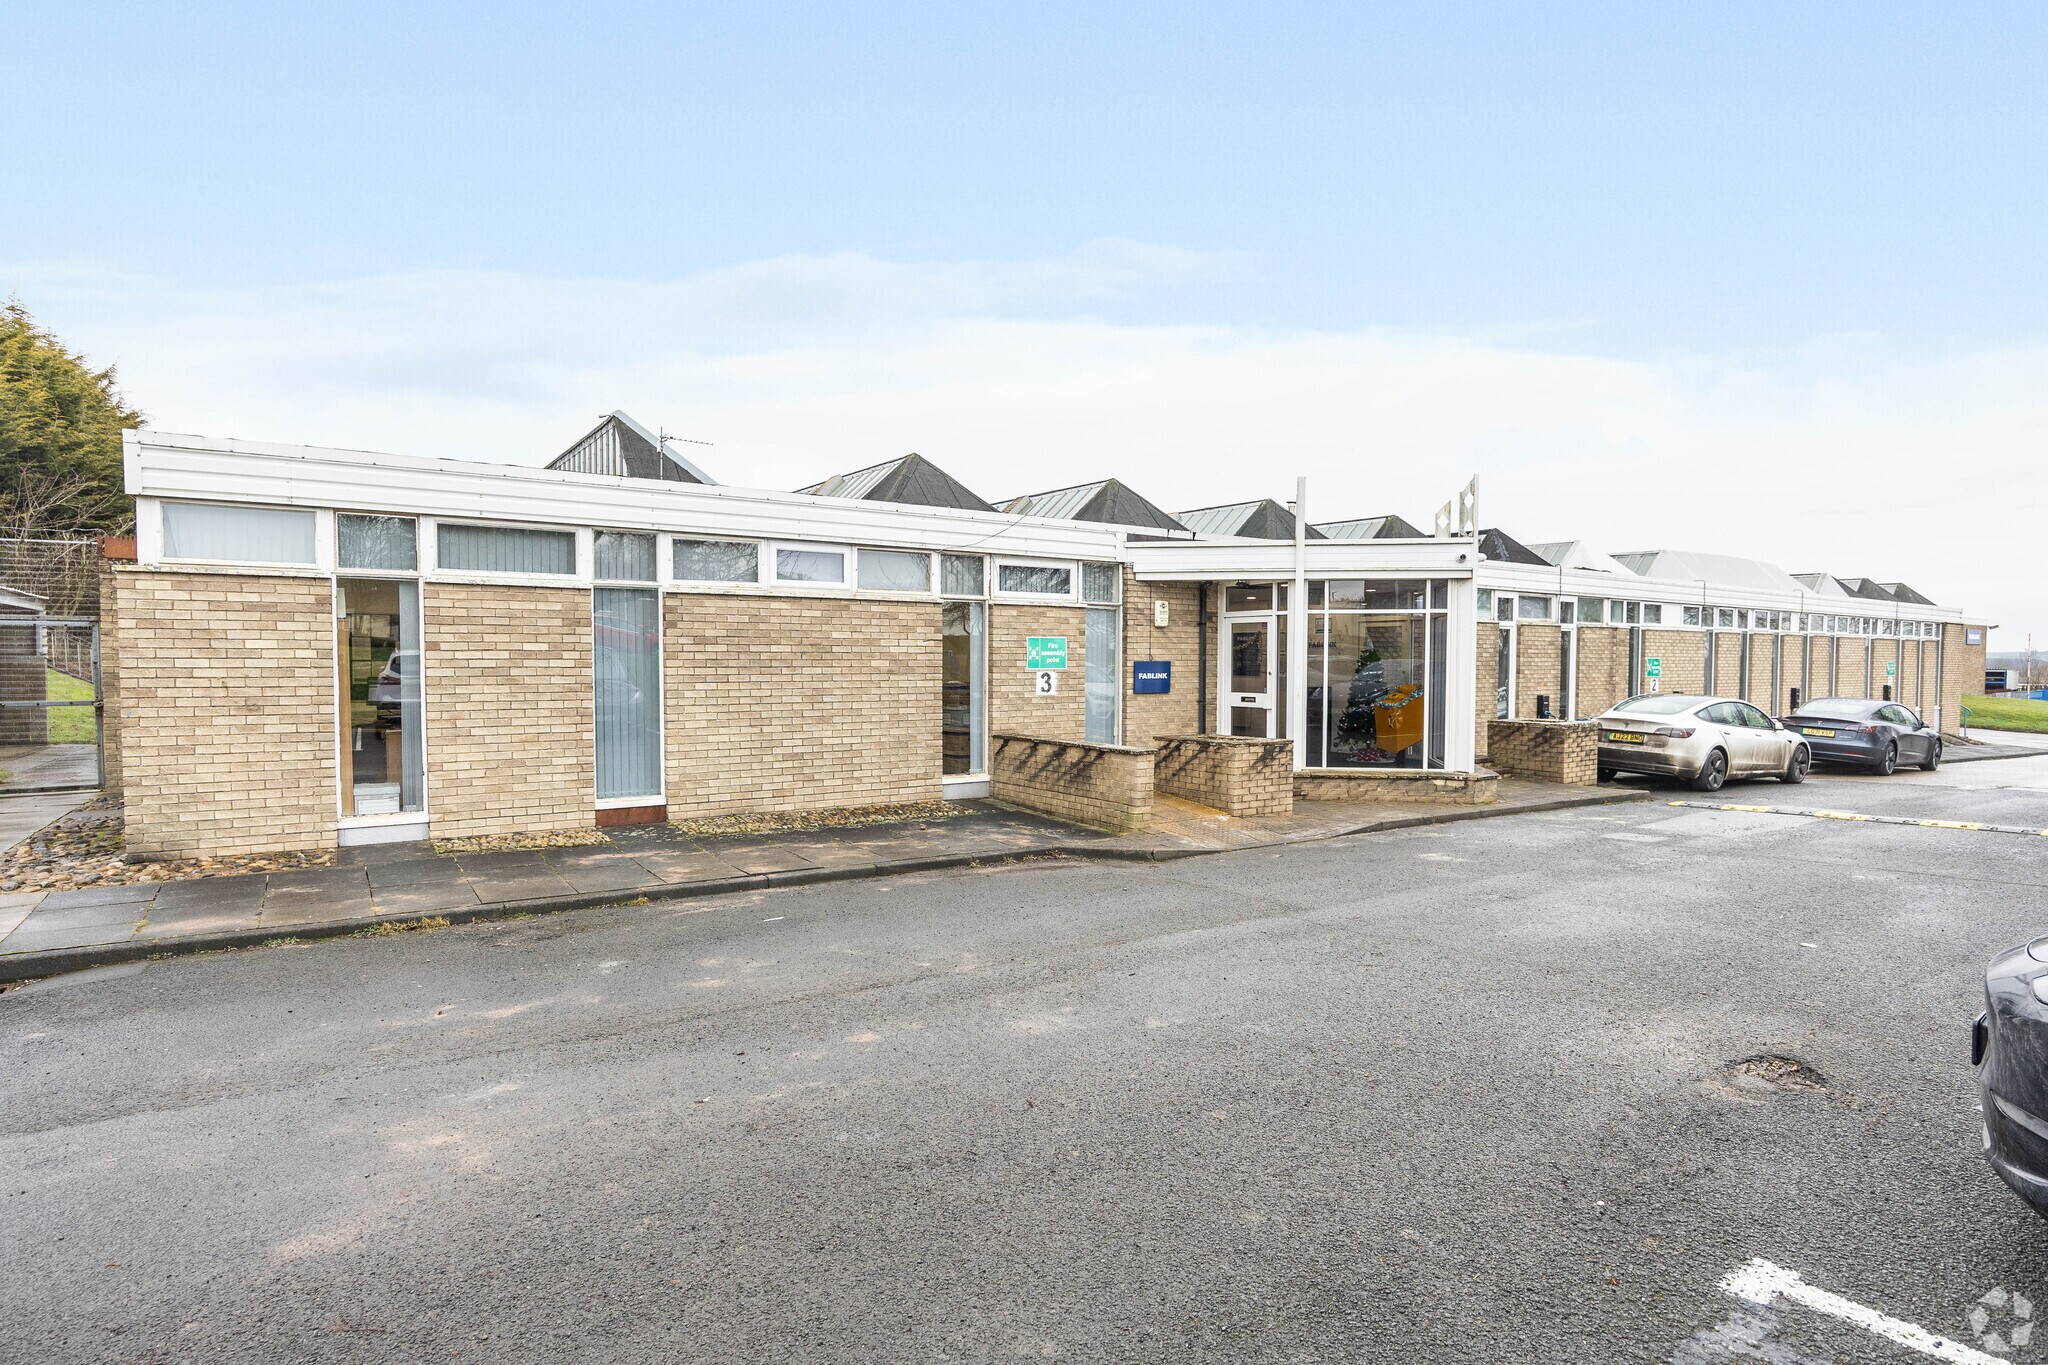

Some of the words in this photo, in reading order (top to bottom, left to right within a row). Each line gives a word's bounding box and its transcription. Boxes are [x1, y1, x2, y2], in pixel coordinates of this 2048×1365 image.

[1041, 649, 1066, 657] assembly
[1138, 672, 1168, 680] FABLINK
[1040, 672, 1052, 693] 3
[1651, 678, 1657, 691] 2
